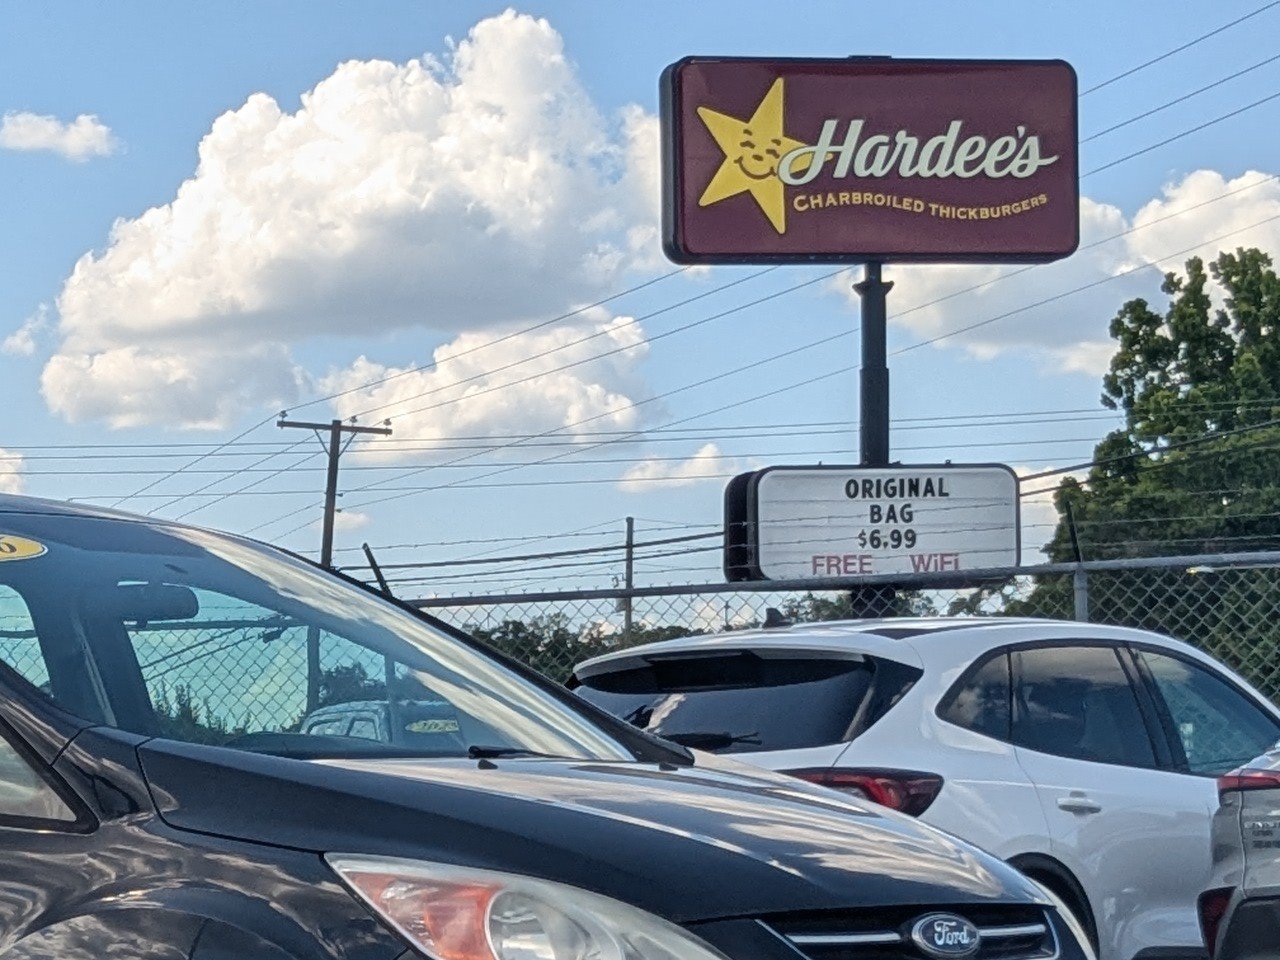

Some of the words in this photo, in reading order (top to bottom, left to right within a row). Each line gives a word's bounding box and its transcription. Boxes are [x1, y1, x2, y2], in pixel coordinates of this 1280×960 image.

[777, 118, 1060, 186] Hardee's
[792, 191, 925, 213] CHARBROILED
[927, 193, 1049, 221] THICKBURGERS
[845, 477, 950, 499] ORIGINAL
[869, 503, 914, 524] BAG
[857, 528, 918, 550] $6.99
[811, 554, 873, 576] FREE
[933, 920, 970, 946] Ford
